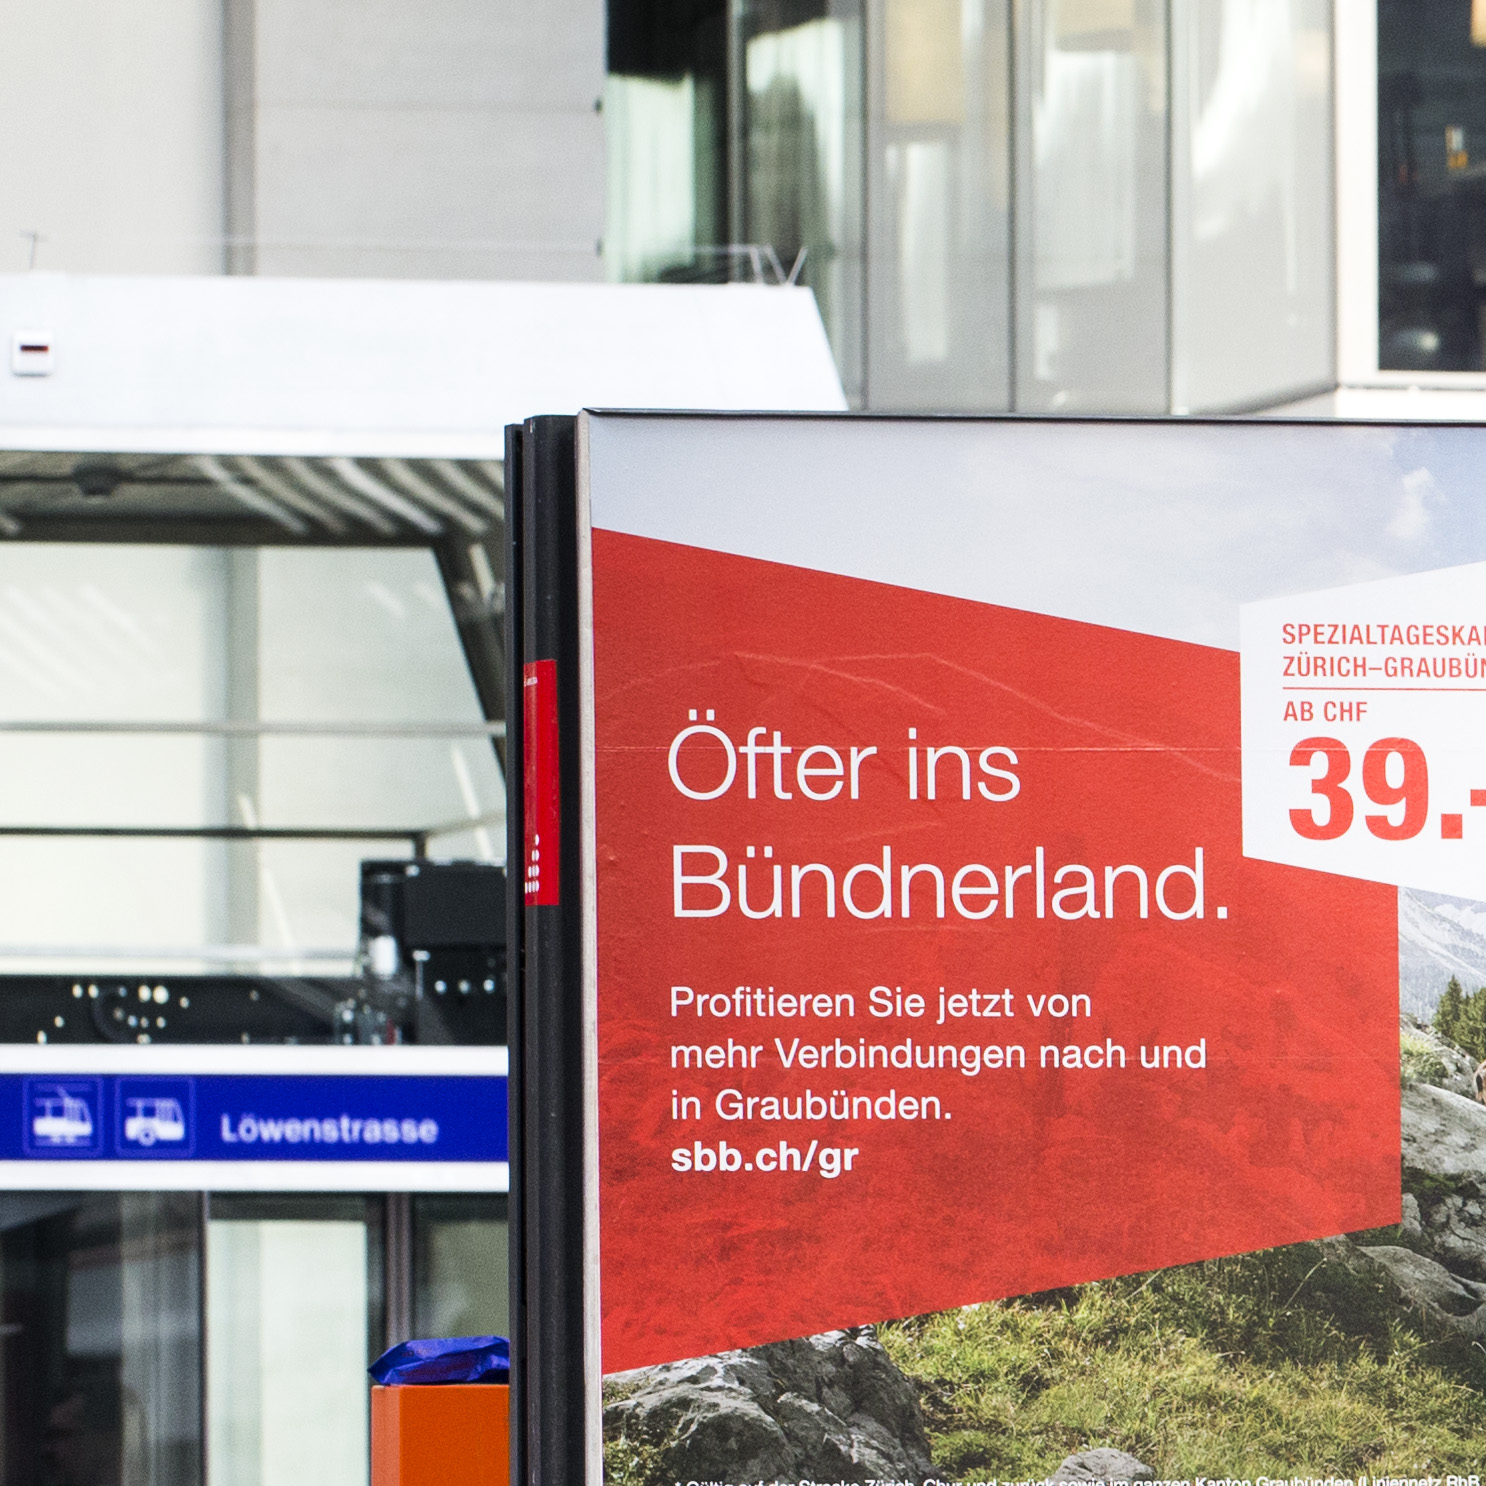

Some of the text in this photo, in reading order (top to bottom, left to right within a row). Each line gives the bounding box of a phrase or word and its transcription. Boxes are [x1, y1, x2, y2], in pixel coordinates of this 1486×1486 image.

[1284, 701, 1366, 721] AB CHF
[669, 709, 1020, 801] Öfter ins
[674, 845, 1227, 920] Bündnerland.
[671, 986, 1090, 1024] Profitieren Sie jetzt von
[672, 1038, 1205, 1076] mehr Verbindungen nach und
[673, 1089, 951, 1120] in Graubünden.
[222, 1115, 438, 1143] Löwenstrasse
[672, 1140, 859, 1178] sbb.ch/gr
